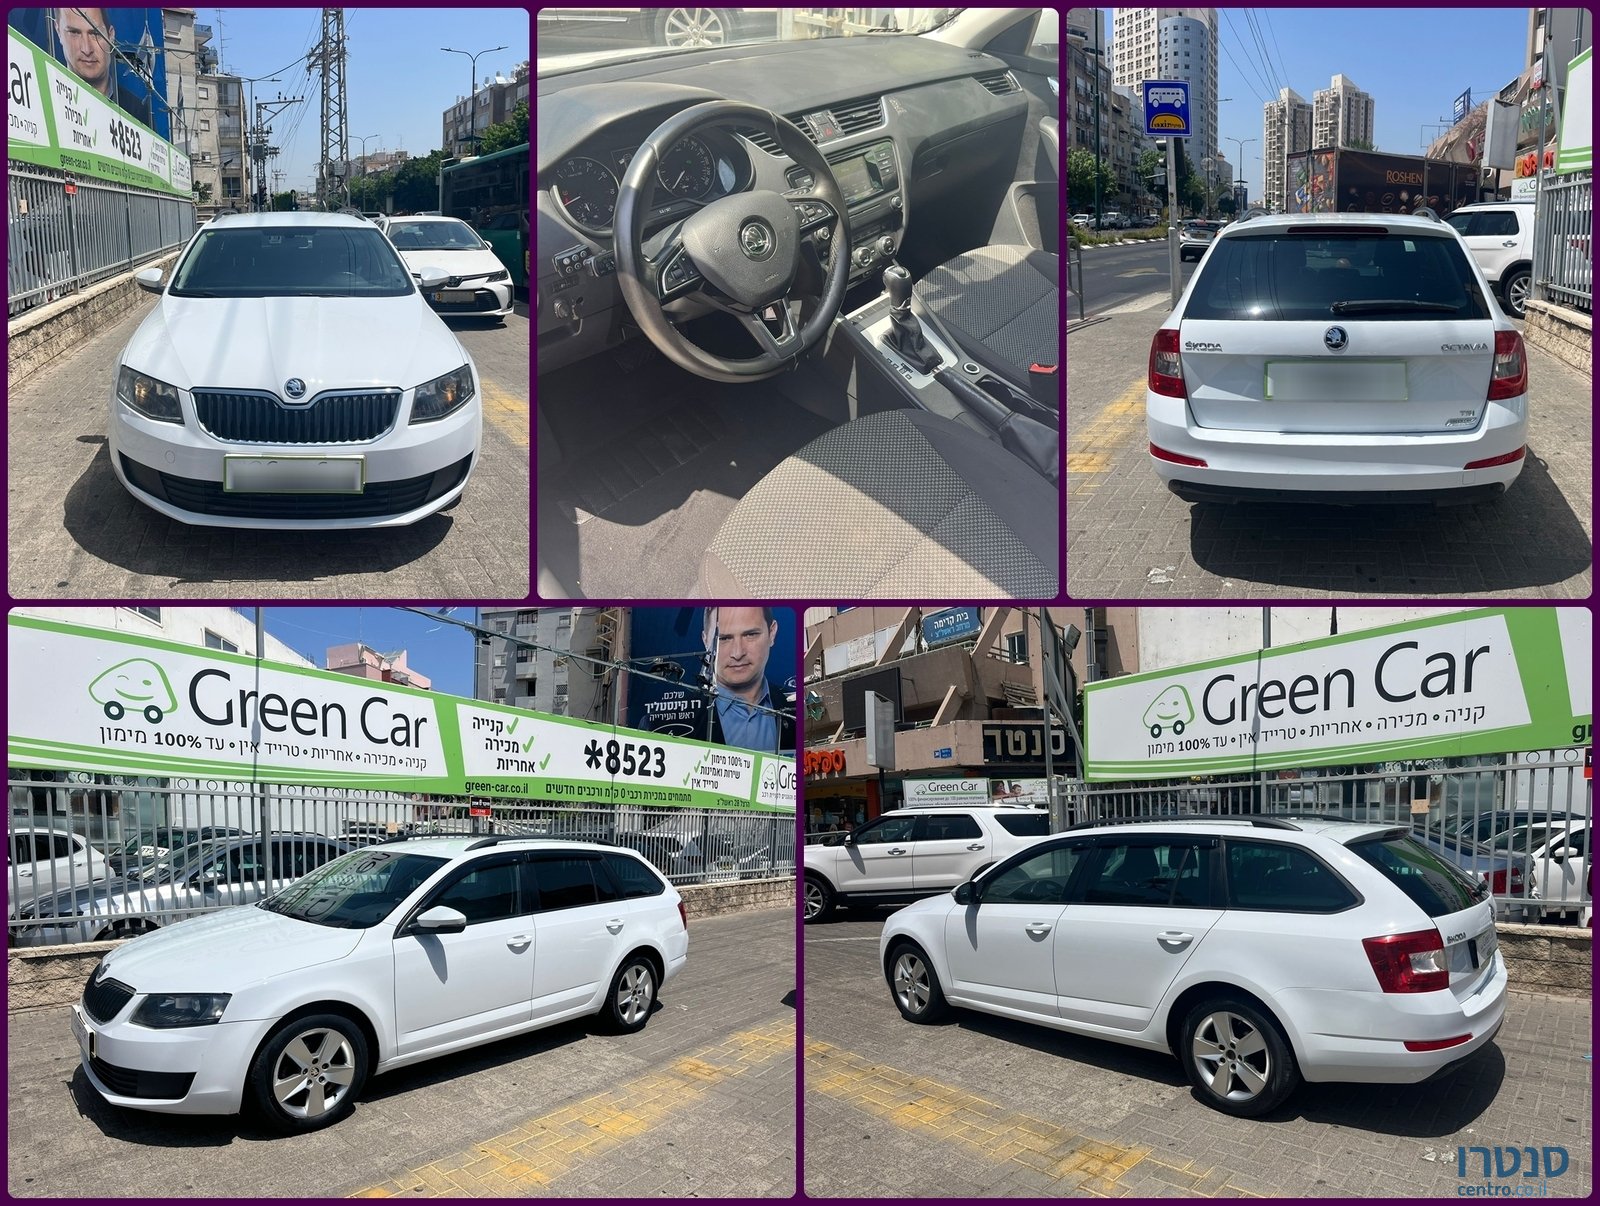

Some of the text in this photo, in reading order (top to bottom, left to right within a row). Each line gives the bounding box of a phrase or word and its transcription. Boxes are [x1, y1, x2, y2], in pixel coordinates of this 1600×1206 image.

[8, 61, 32, 109] ar
[64, 105, 83, 127] מכירה
[1386, 170, 1423, 185] ROSHEN
[1440, 343, 1488, 352] OCTAVIA
[933, 612, 969, 630] בית קדימה
[1202, 641, 1490, 726] Green Car
[188, 668, 428, 749] Green Car
[644, 699, 701, 714] רז קינסטליך
[649, 711, 695, 722] ראש העירייה
[472, 716, 504, 736] קנייה
[1146, 705, 1486, 758] קניה מכירה אחריות טרייד אין עד 100% מימון
[99, 725, 428, 771] קניה מכירה אחריות טרייד אין עד 100% מימון
[485, 737, 520, 754] מכירה
[984, 729, 1066, 756] סנטר
[496, 757, 536, 773] אחריות
[711, 754, 751, 769] עד 100% מימון
[465, 781, 529, 794] green-car.co.il
[545, 783, 575, 795] חדשים
[577, 785, 603, 797] ורכבים
[691, 778, 701, 790] אין
[928, 780, 979, 792] Green Car
[627, 789, 643, 800] רכבי
[643, 790, 667, 801] במכירת
[668, 792, 692, 802] מתמחים
